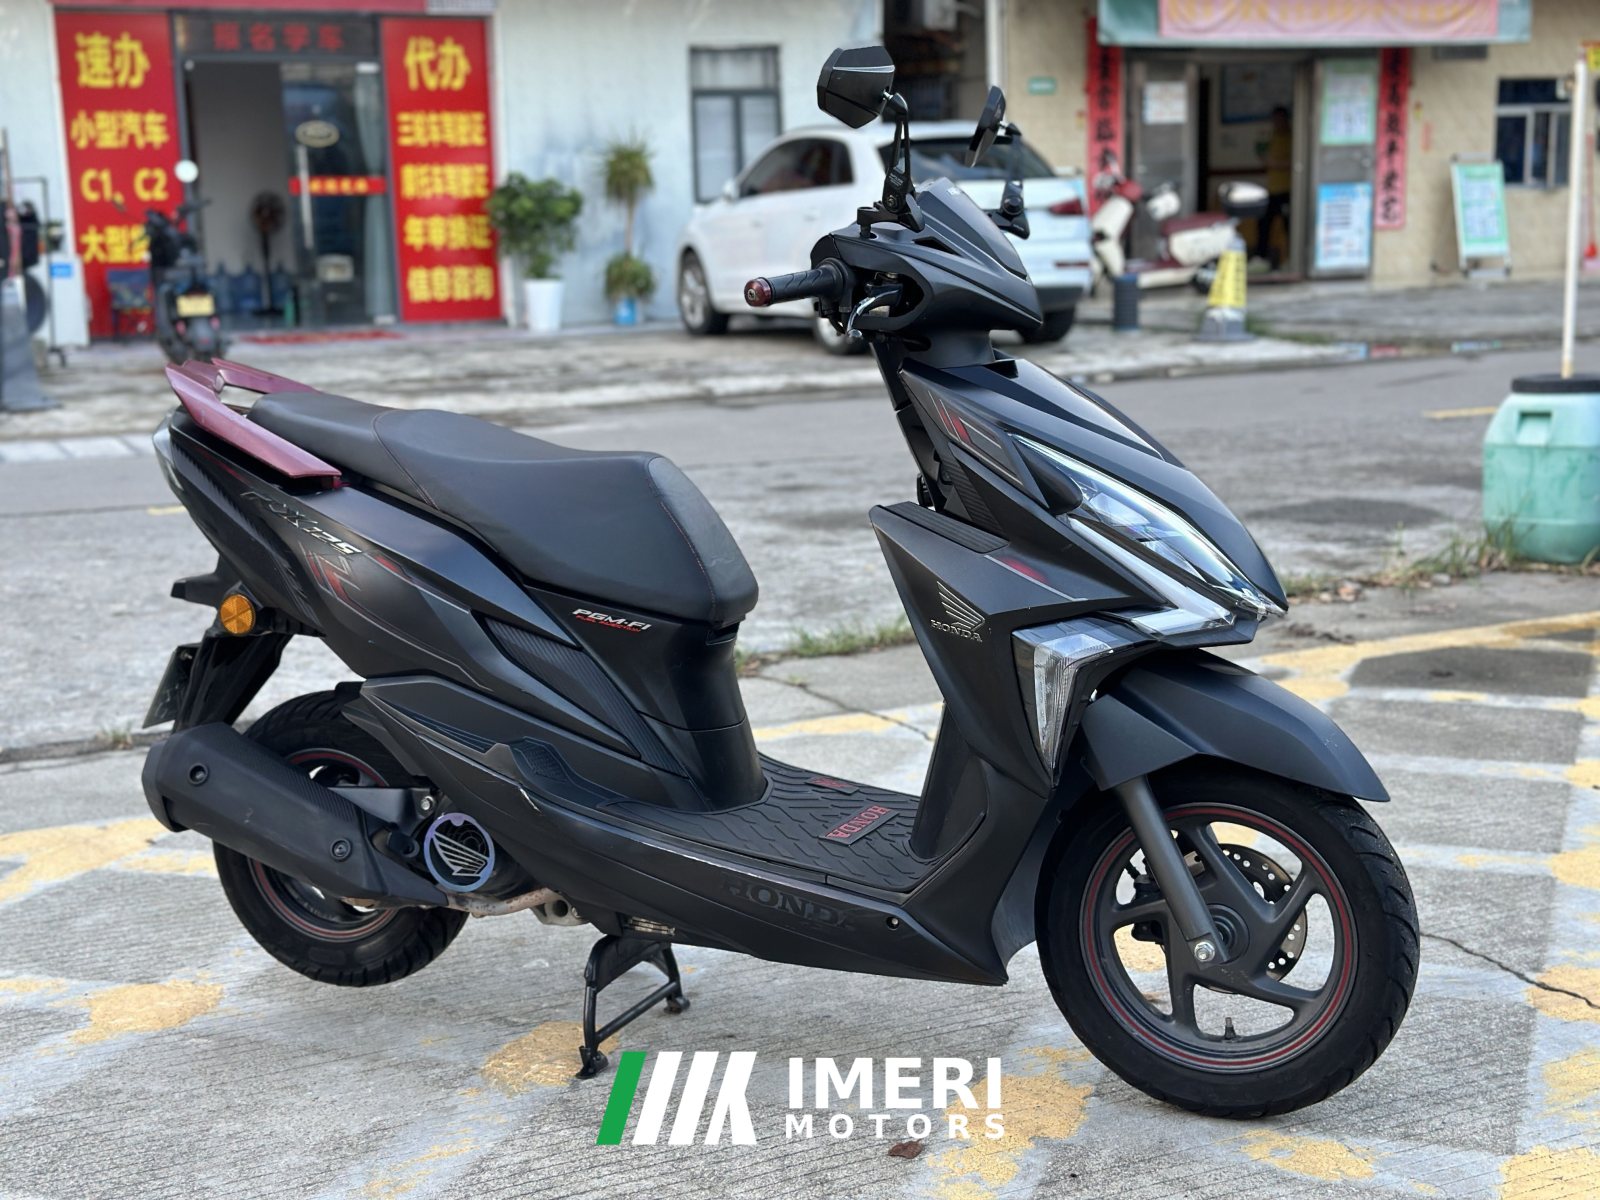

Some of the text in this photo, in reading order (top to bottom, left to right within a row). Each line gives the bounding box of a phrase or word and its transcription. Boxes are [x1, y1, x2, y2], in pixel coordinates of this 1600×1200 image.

[75, 31, 151, 89] 速办
[404, 35, 471, 91] 代办
[70, 109, 170, 150] 小型汽车
[930, 619, 983, 644] HONDA
[825, 805, 892, 838] HONDA
